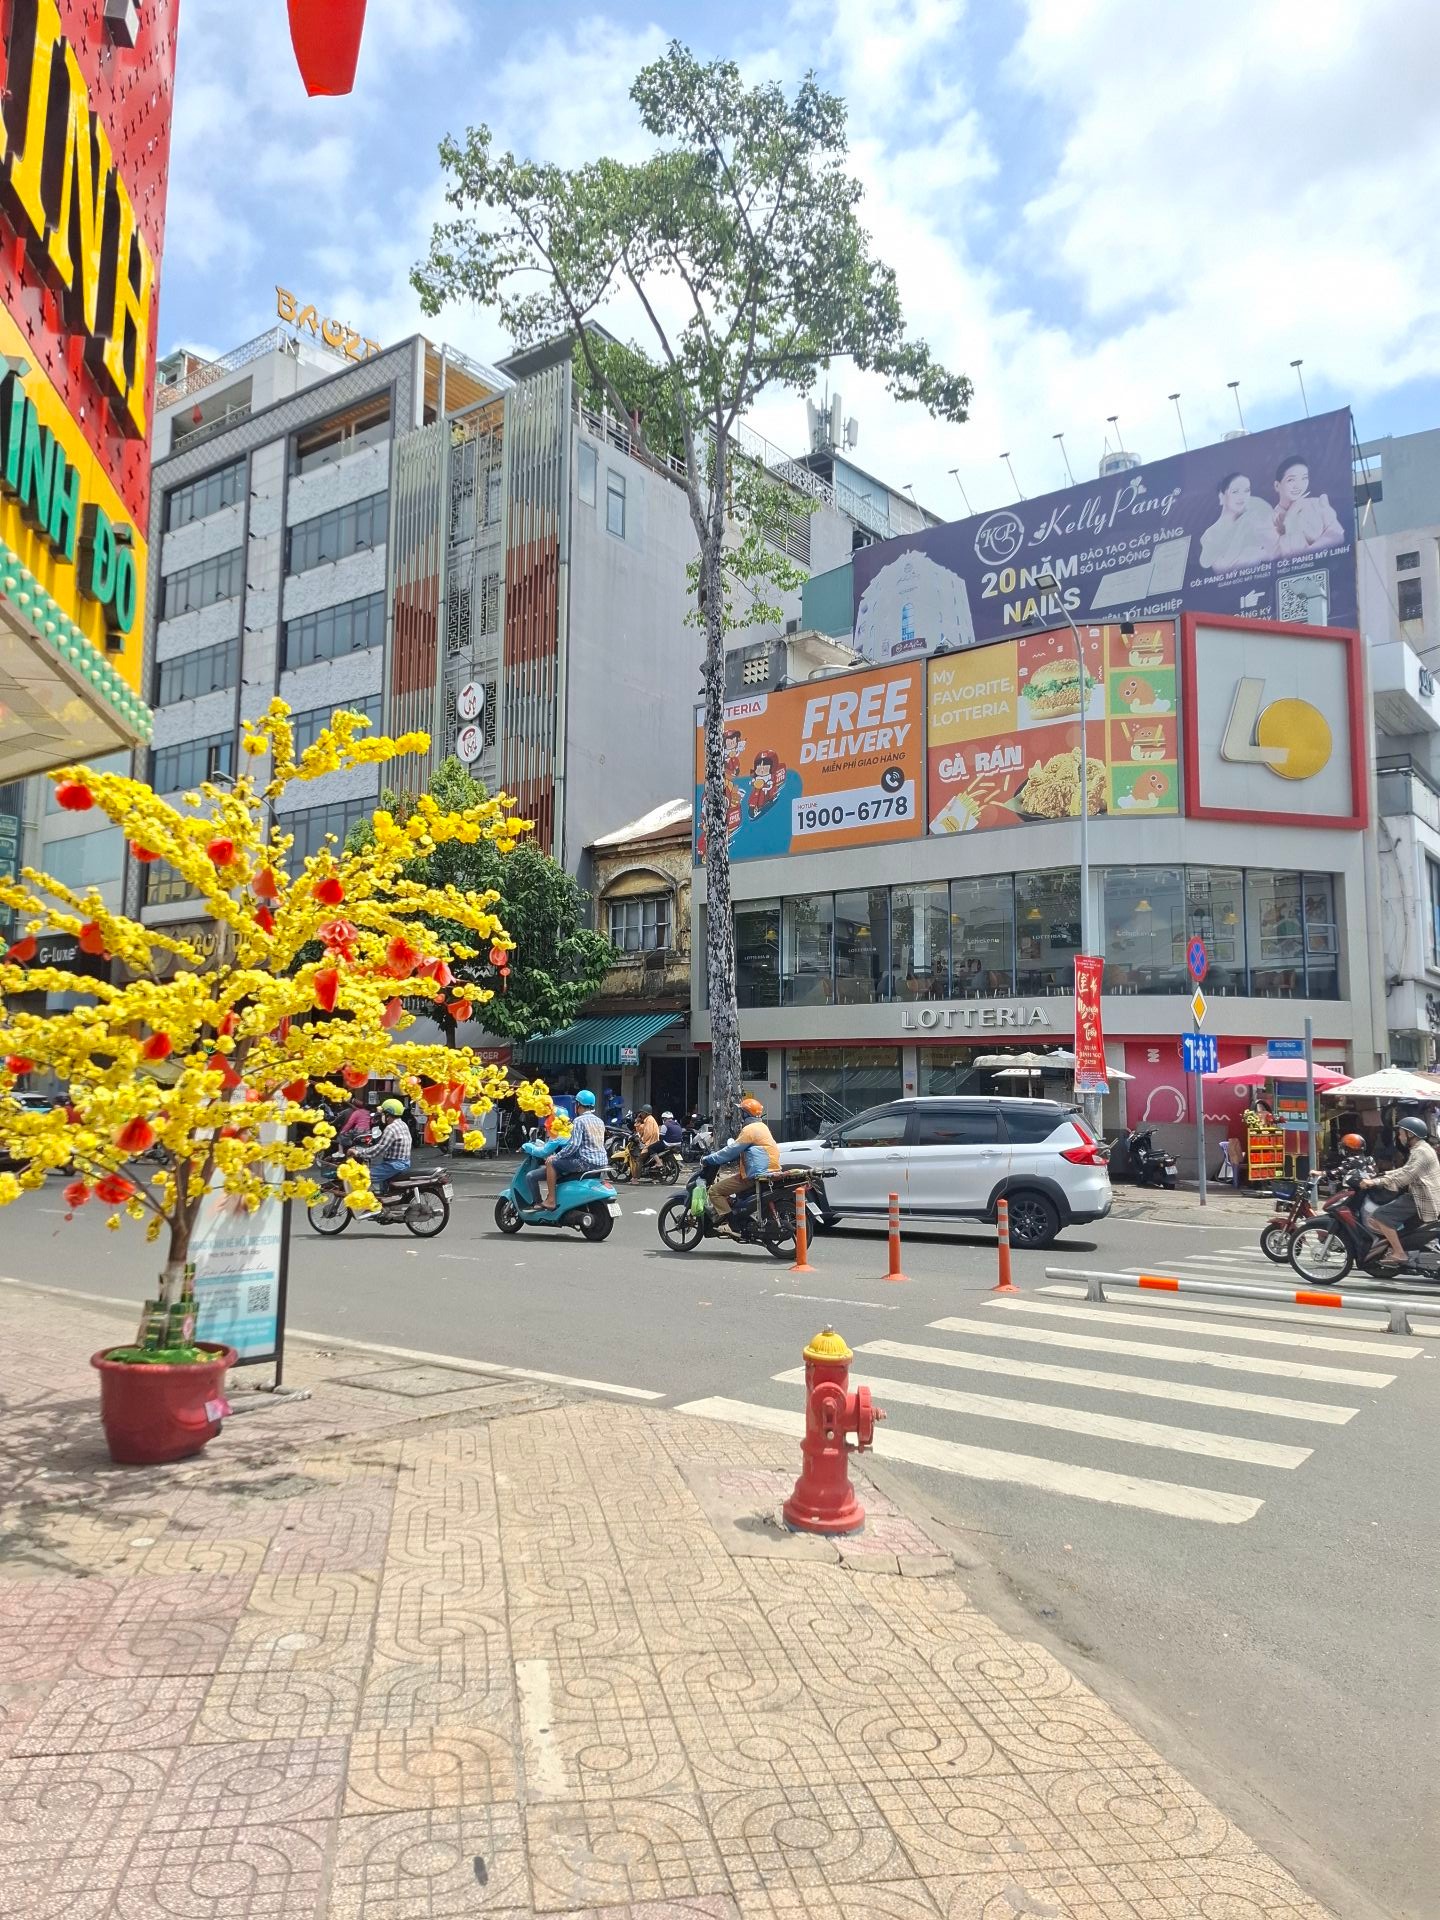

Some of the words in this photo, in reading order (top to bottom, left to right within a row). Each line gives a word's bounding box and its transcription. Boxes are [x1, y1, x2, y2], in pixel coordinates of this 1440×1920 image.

[0, 0, 155, 438] INH
[0, 352, 80, 564] ÍNH
[1105, 541, 1127, 557] TẠO
[1128, 532, 1151, 548] CẤP
[1095, 558, 1116, 571] LAO
[1118, 548, 1151, 565] ĐỘNG
[1292, 553, 1314, 565] PANG
[981, 567, 1016, 599] 20
[1204, 574, 1224, 585] PANG
[1003, 587, 1081, 625] NAILS
[1143, 598, 1183, 615] NGHIỆP
[932, 669, 955, 686] My
[802, 678, 912, 739] FREE
[932, 700, 1010, 728] LOTTERIA
[800, 723, 912, 764] DELIVERY
[821, 760, 842, 774] MIỄN
[842, 758, 857, 771] PHÍ
[857, 756, 879, 768] GIAO
[880, 751, 906, 765] HÀNG
[938, 752, 968, 779] GÀ
[975, 743, 1023, 772] RÁN
[797, 796, 908, 830] 1900-6778
[901, 1006, 1050, 1029] LOTTERIA
